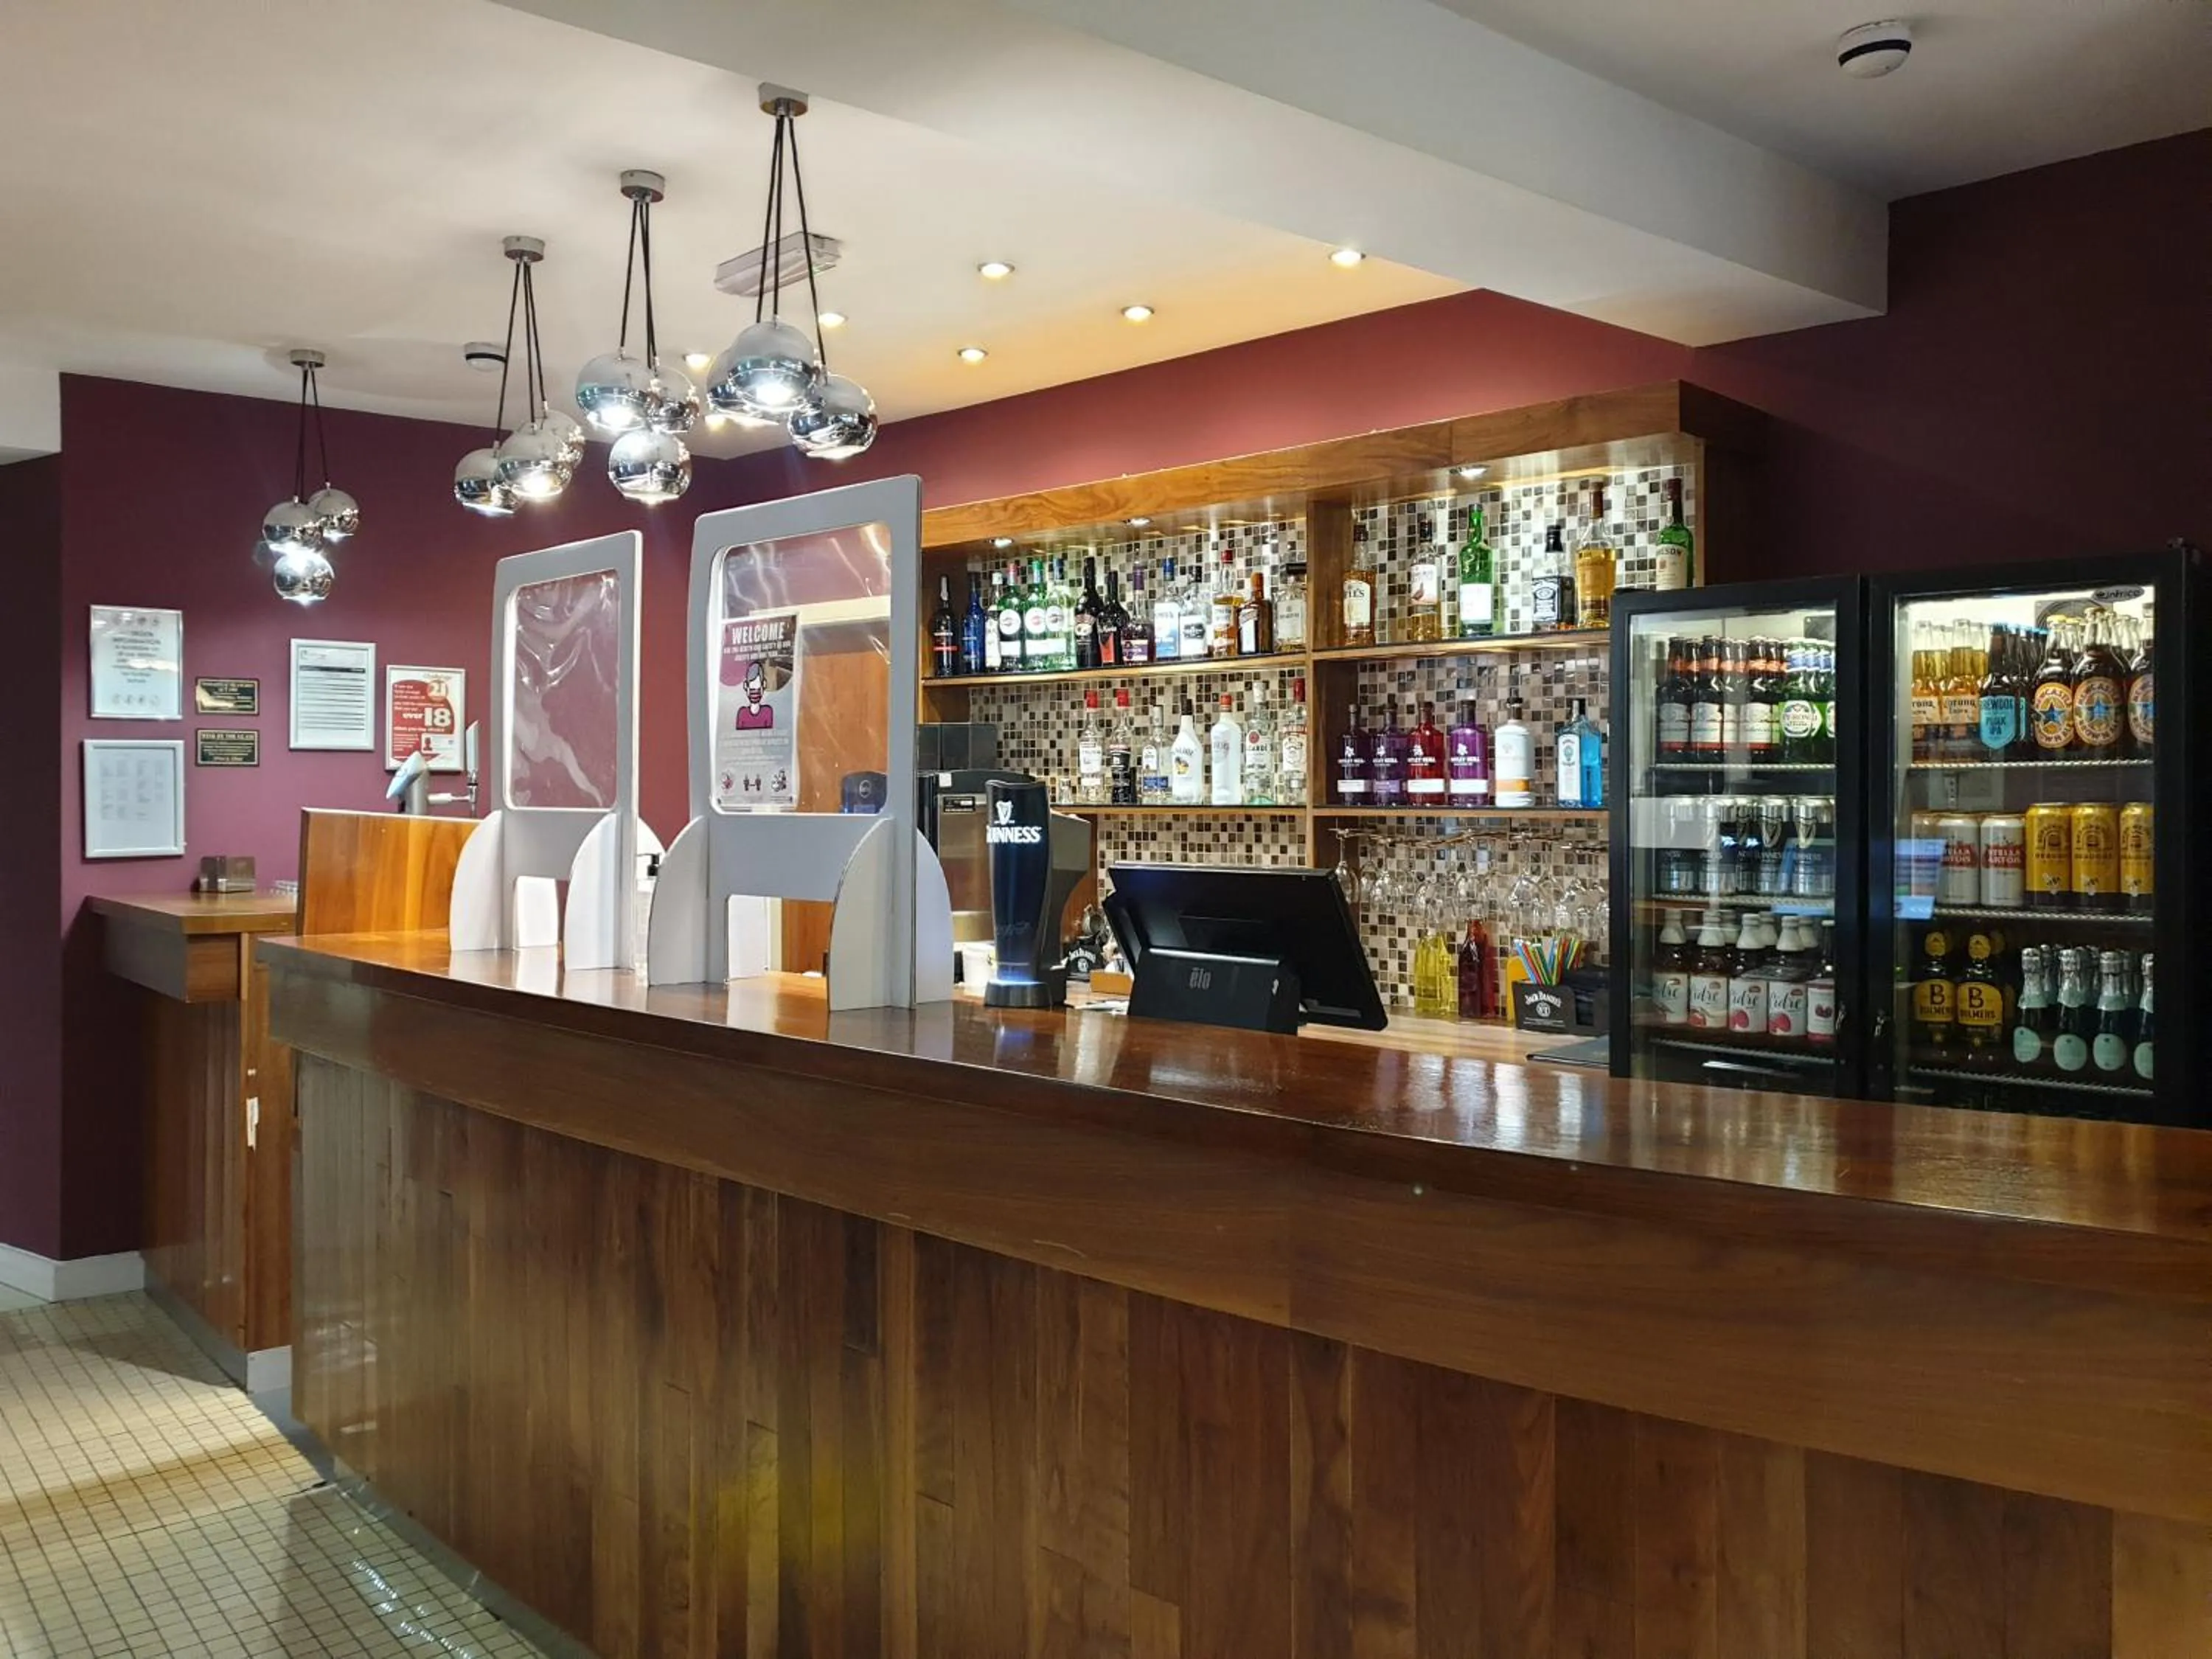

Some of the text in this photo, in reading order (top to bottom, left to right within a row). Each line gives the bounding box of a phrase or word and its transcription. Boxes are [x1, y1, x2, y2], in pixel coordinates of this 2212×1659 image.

[732, 622, 785, 645] WELCOME
[425, 707, 451, 727] 18
[1930, 984, 1946, 1005] B
[1968, 987, 1985, 1008] B
